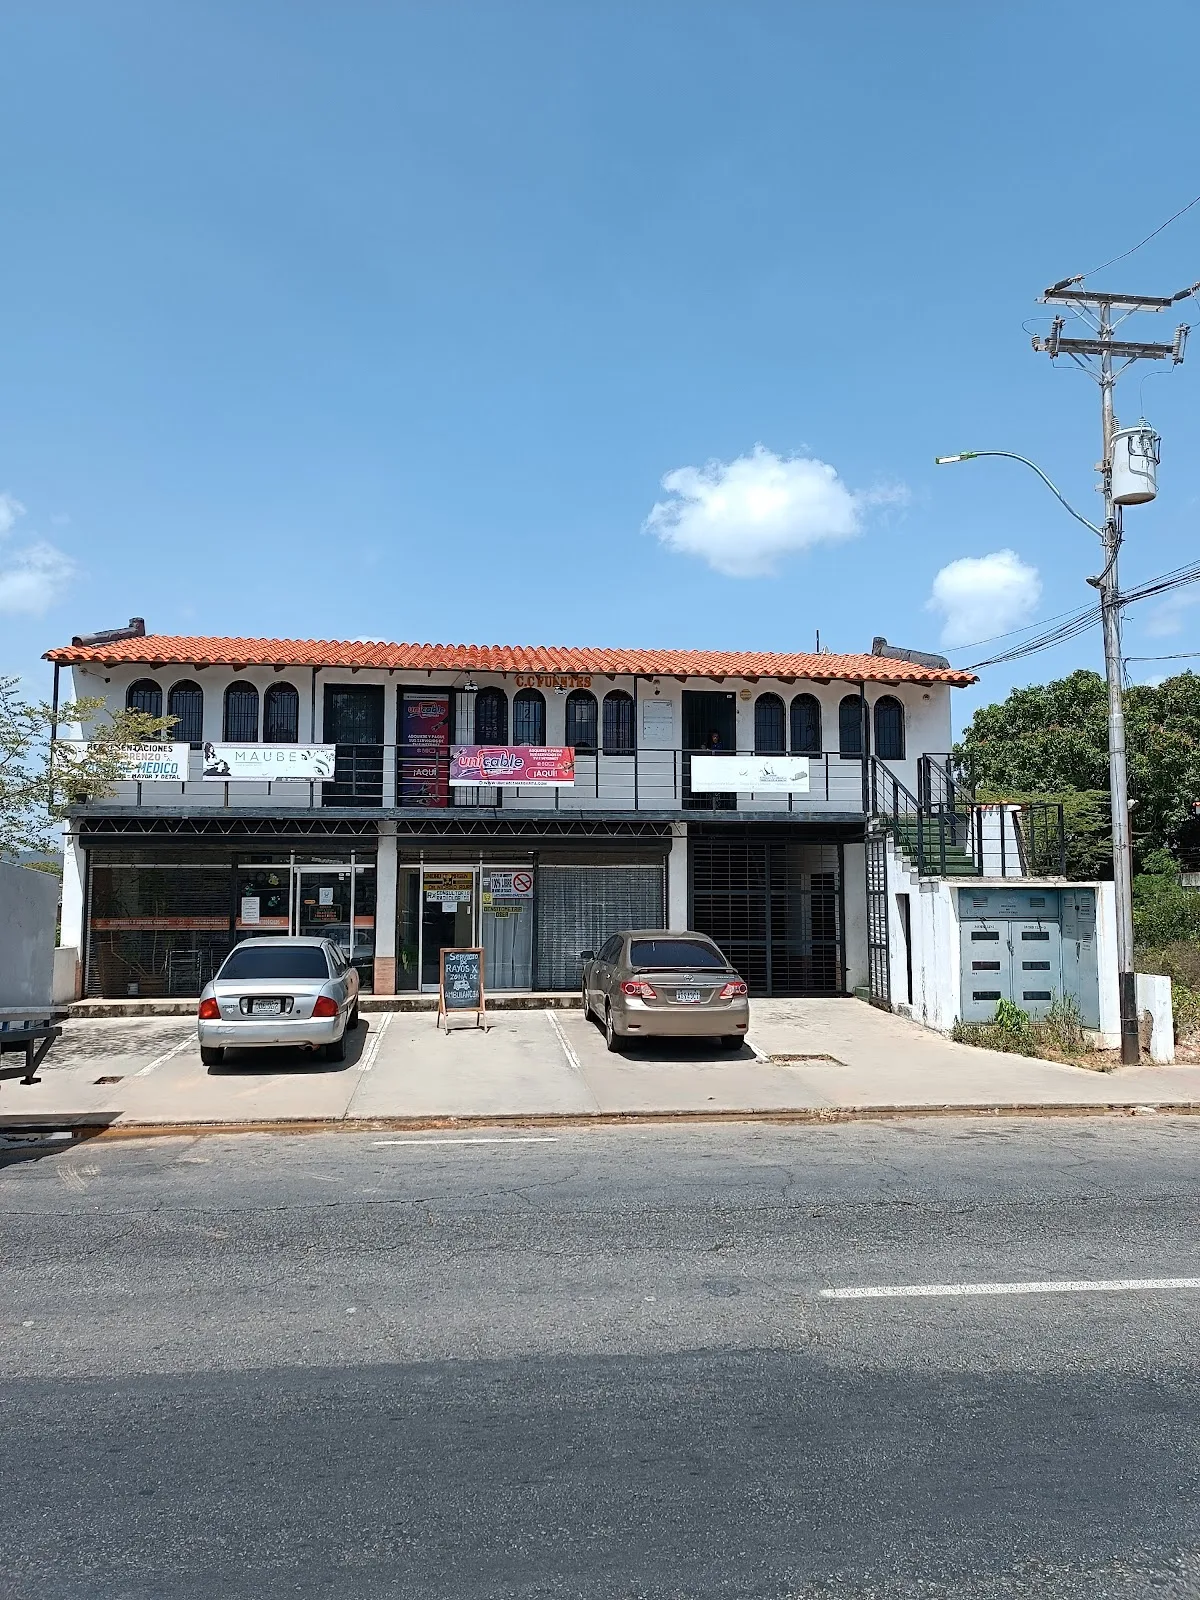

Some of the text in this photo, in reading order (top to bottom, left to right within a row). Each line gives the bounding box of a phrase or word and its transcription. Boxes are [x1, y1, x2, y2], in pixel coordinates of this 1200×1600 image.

[539, 676, 591, 688] FUENTES
[235, 751, 297, 762] MAUBE
[459, 753, 524, 769] unicable
[137, 761, 179, 774] MEDICO
[534, 768, 558, 778] ¡AQUÍ!
[446, 964, 478, 973] RAYOS X
[445, 990, 479, 998] AMBULANCIA
